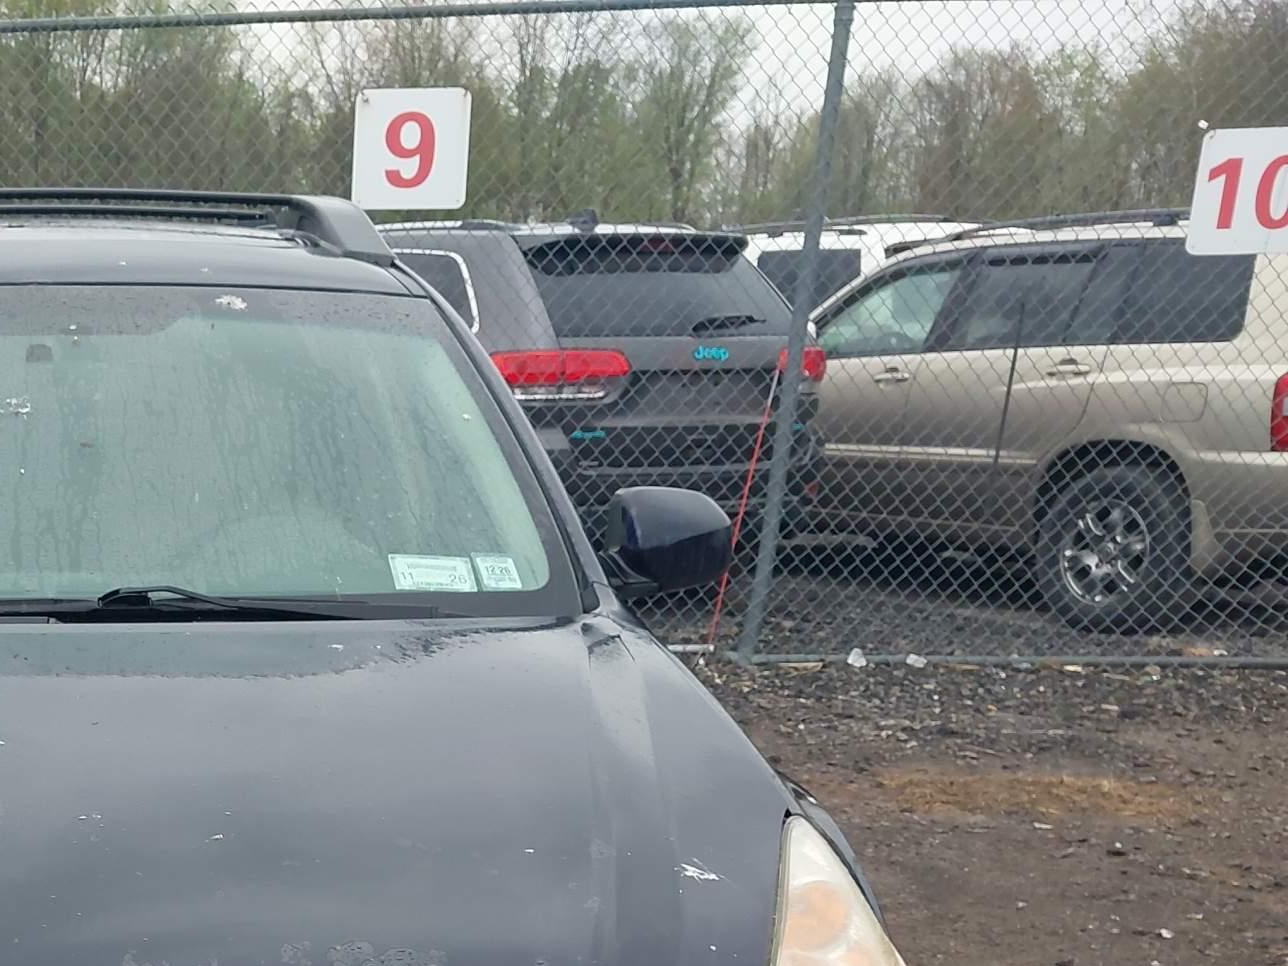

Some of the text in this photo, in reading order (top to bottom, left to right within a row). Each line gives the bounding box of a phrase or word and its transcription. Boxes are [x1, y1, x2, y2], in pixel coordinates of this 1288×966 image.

[385, 110, 436, 189] 9
[1207, 154, 1288, 230] 10
[694, 345, 729, 361] Jeep
